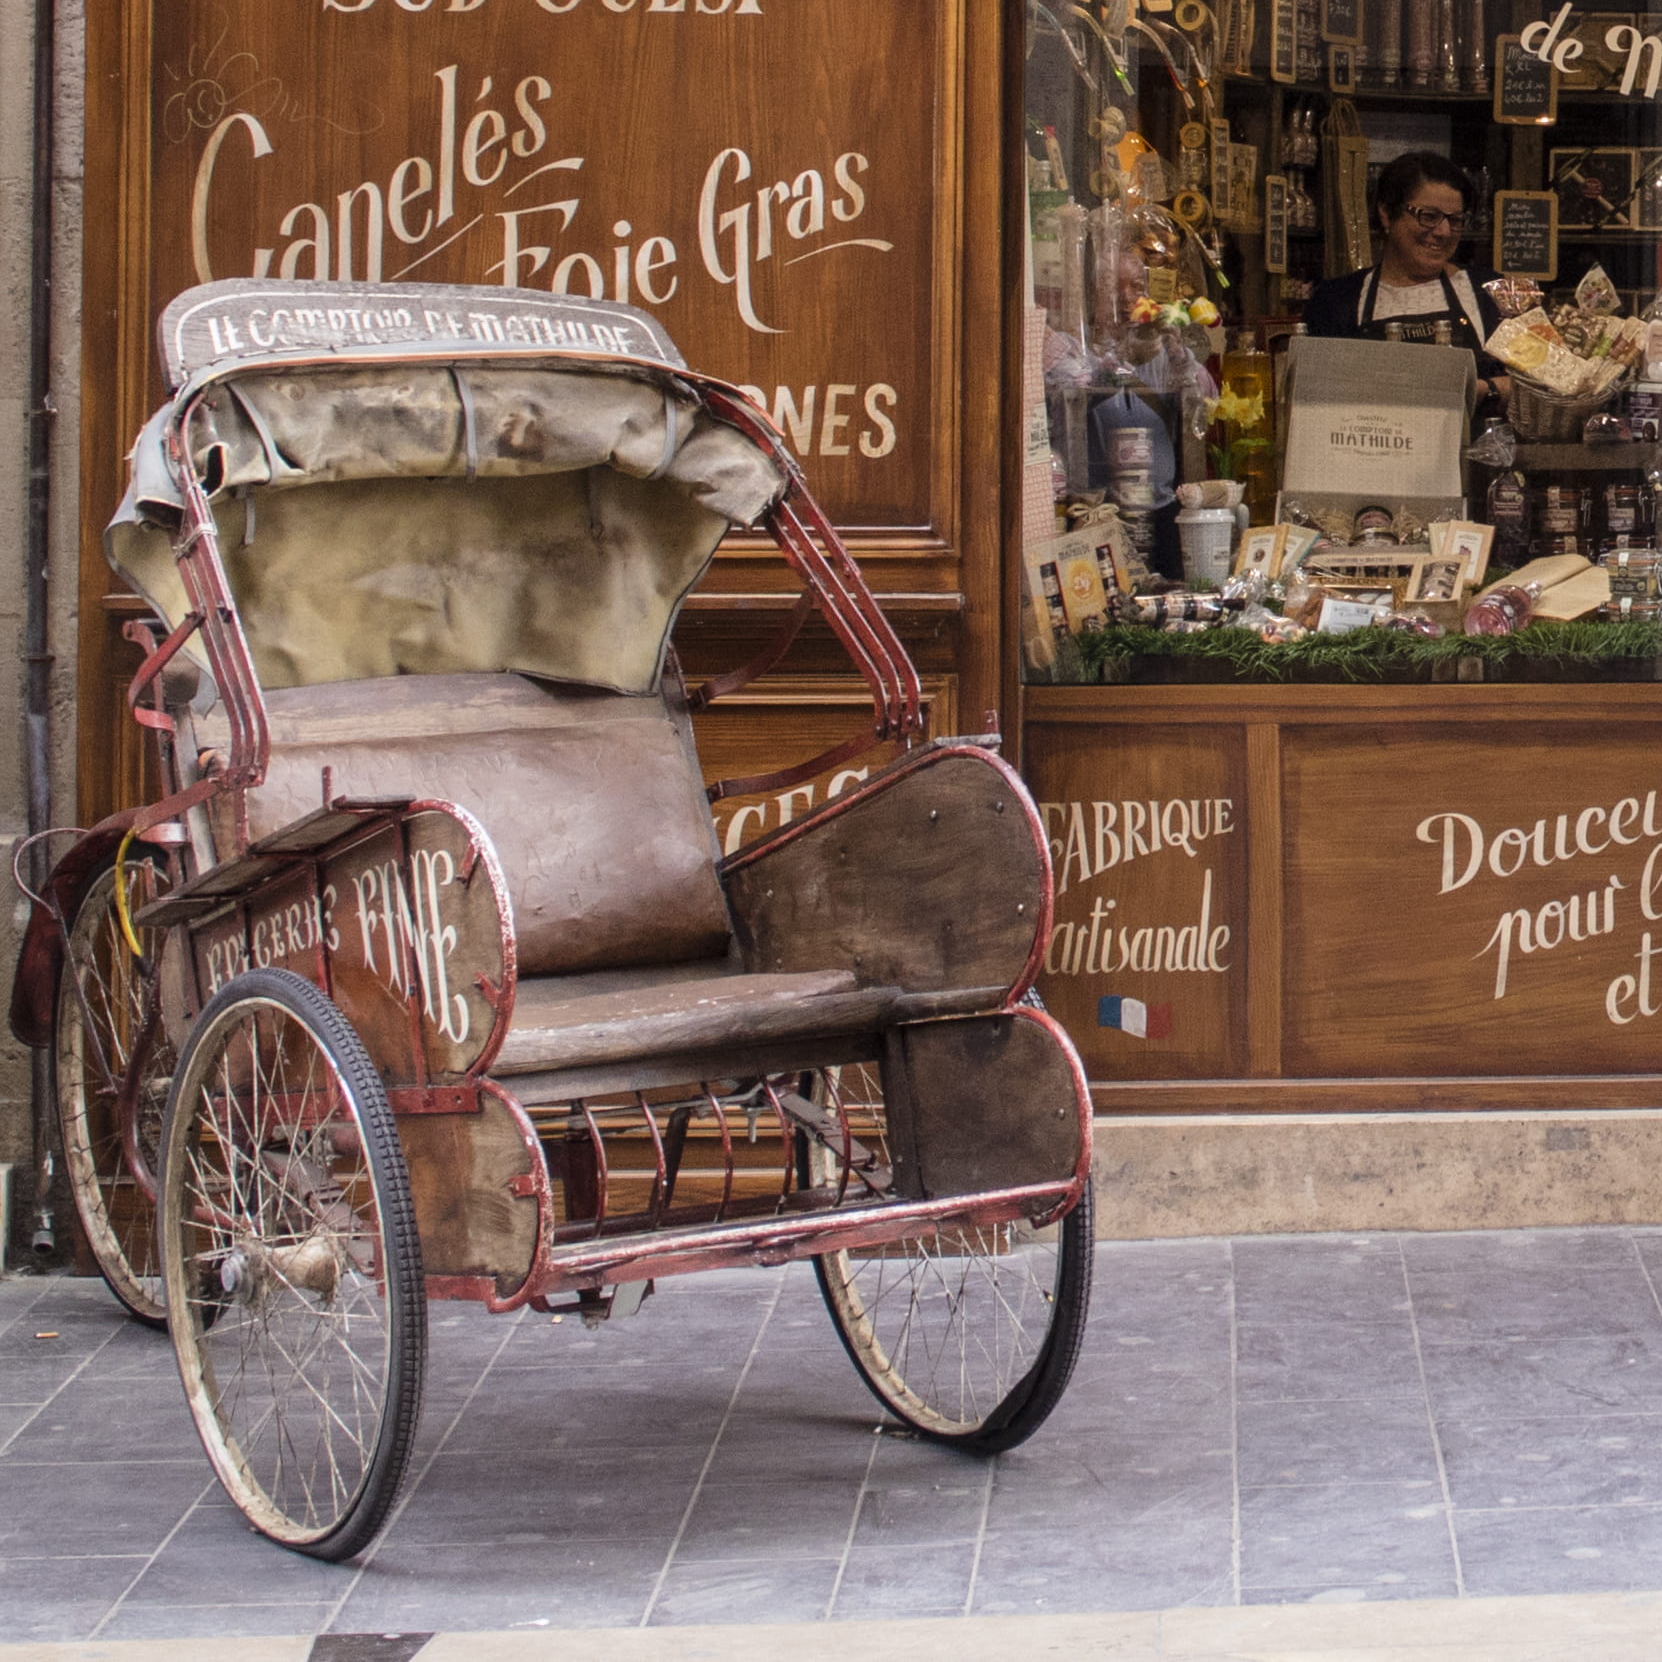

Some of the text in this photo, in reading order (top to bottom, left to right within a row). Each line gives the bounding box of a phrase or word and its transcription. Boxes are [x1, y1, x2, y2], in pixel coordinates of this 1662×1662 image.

[1520, 2, 1584, 74] de
[485, 146, 872, 334] Foie Gras
[207, 315, 245, 356] LE
[1330, 432, 1414, 451] MATHILDE
[1044, 797, 1234, 896] FABRIQUE
[353, 849, 469, 1044] FINE
[1045, 869, 1231, 975] artisanale
[1472, 874, 1626, 999] pour
[1607, 931, 1662, 1025] et
